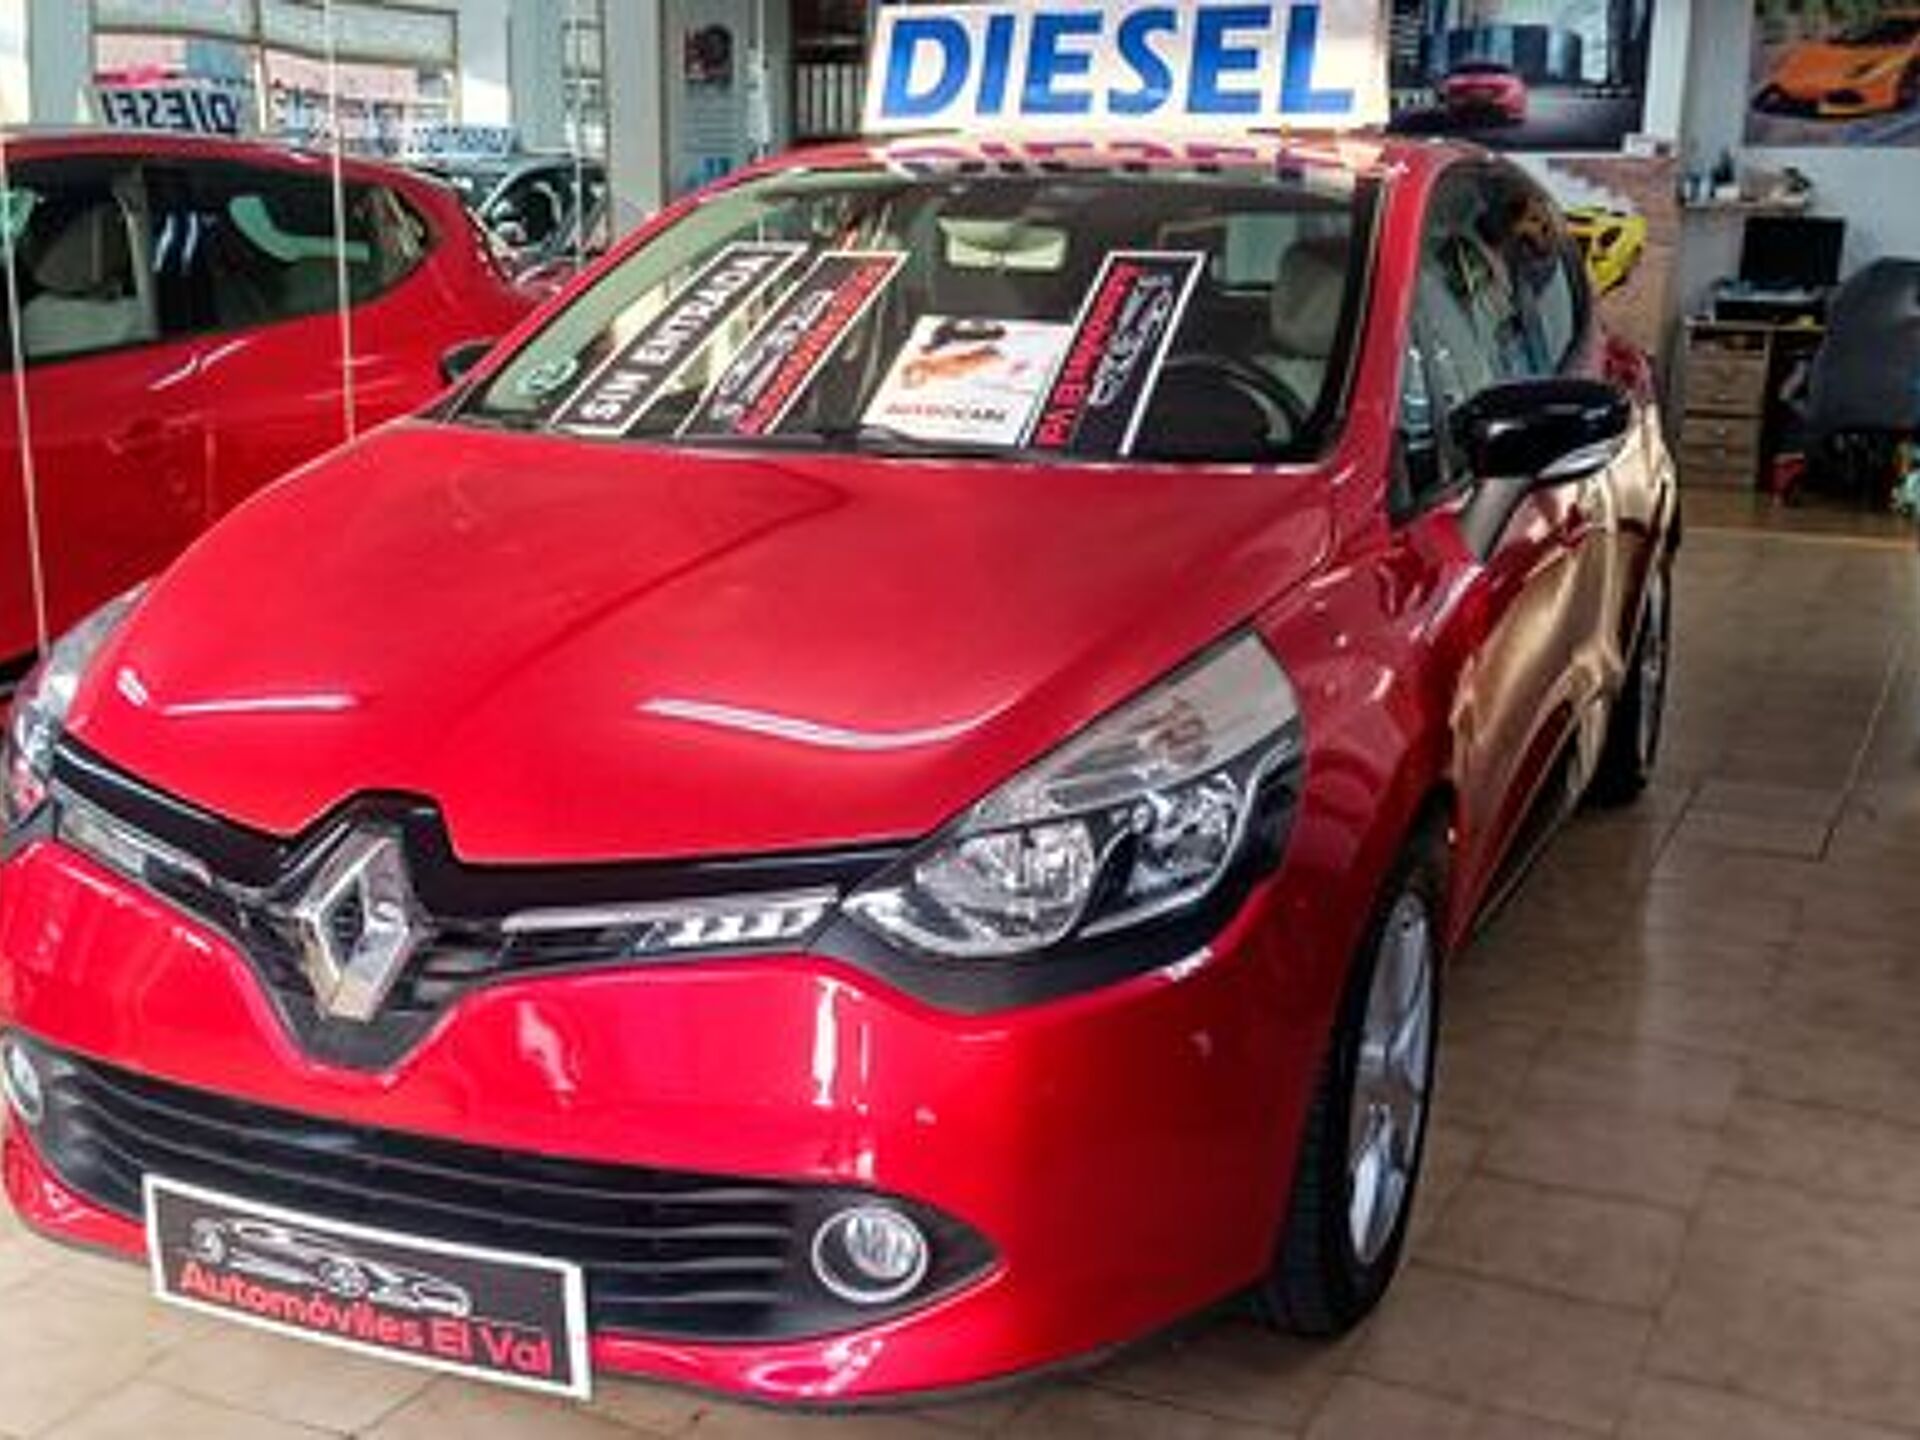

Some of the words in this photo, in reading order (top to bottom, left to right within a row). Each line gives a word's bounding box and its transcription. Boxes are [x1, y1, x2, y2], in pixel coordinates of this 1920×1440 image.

[881, 4, 1356, 118] DIESEL
[579, 368, 650, 421] SIN
[629, 254, 778, 364] ENTRADA
[180, 1261, 424, 1348] Automóviles
[433, 1317, 473, 1357] El
[481, 1326, 552, 1375] Val
